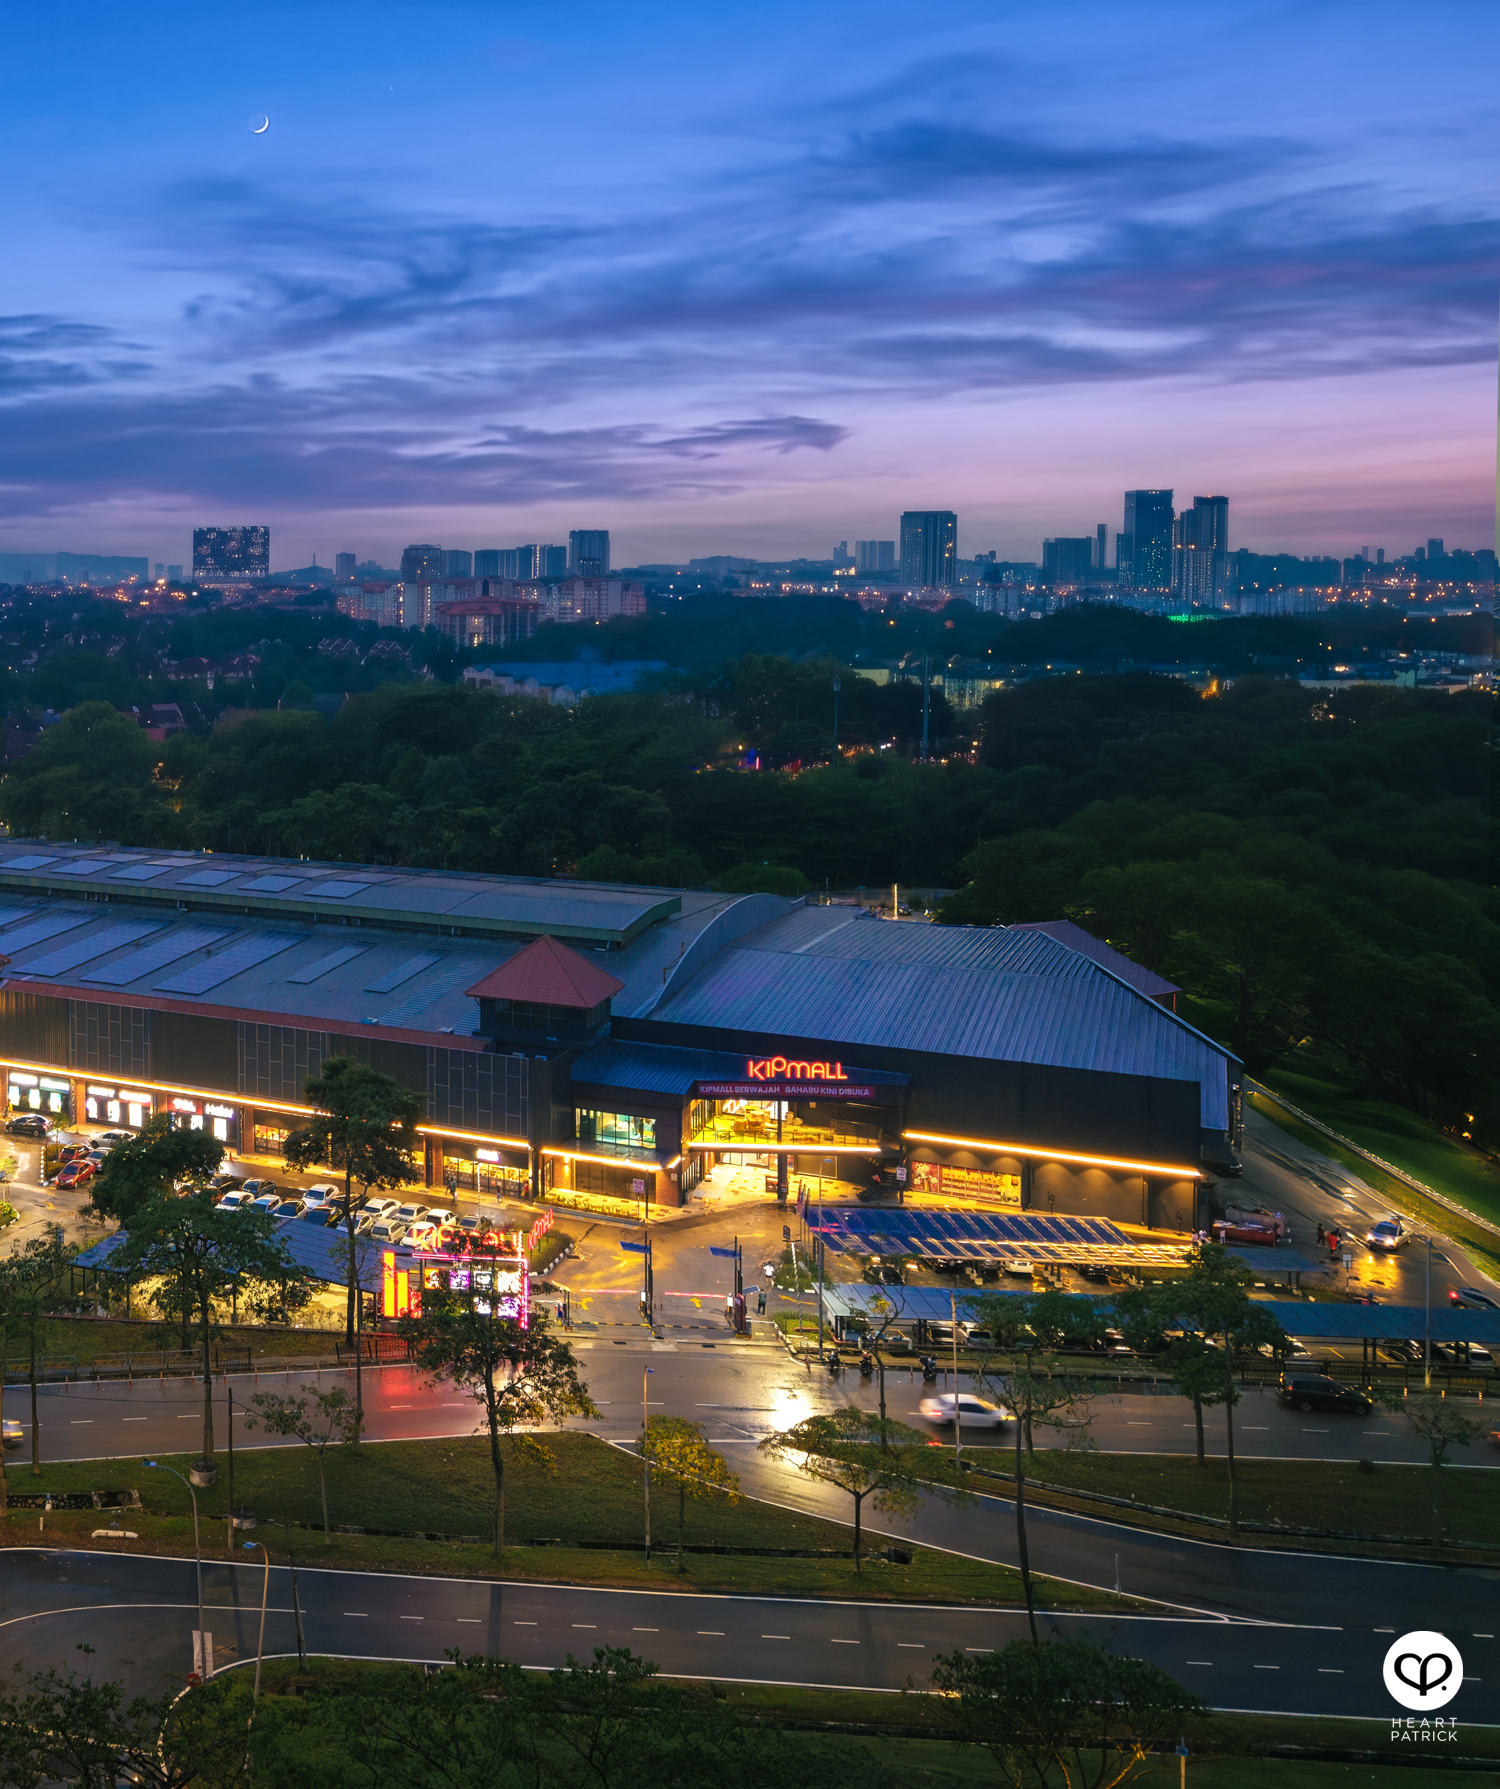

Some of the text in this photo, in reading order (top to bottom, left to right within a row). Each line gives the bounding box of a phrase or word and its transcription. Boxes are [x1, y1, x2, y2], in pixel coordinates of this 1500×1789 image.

[747, 1055, 849, 1080] KIPMALL
[699, 1085, 734, 1093] KIPMALL
[785, 1086, 819, 1094] BAHARU
[838, 1087, 870, 1096] DIBUKA
